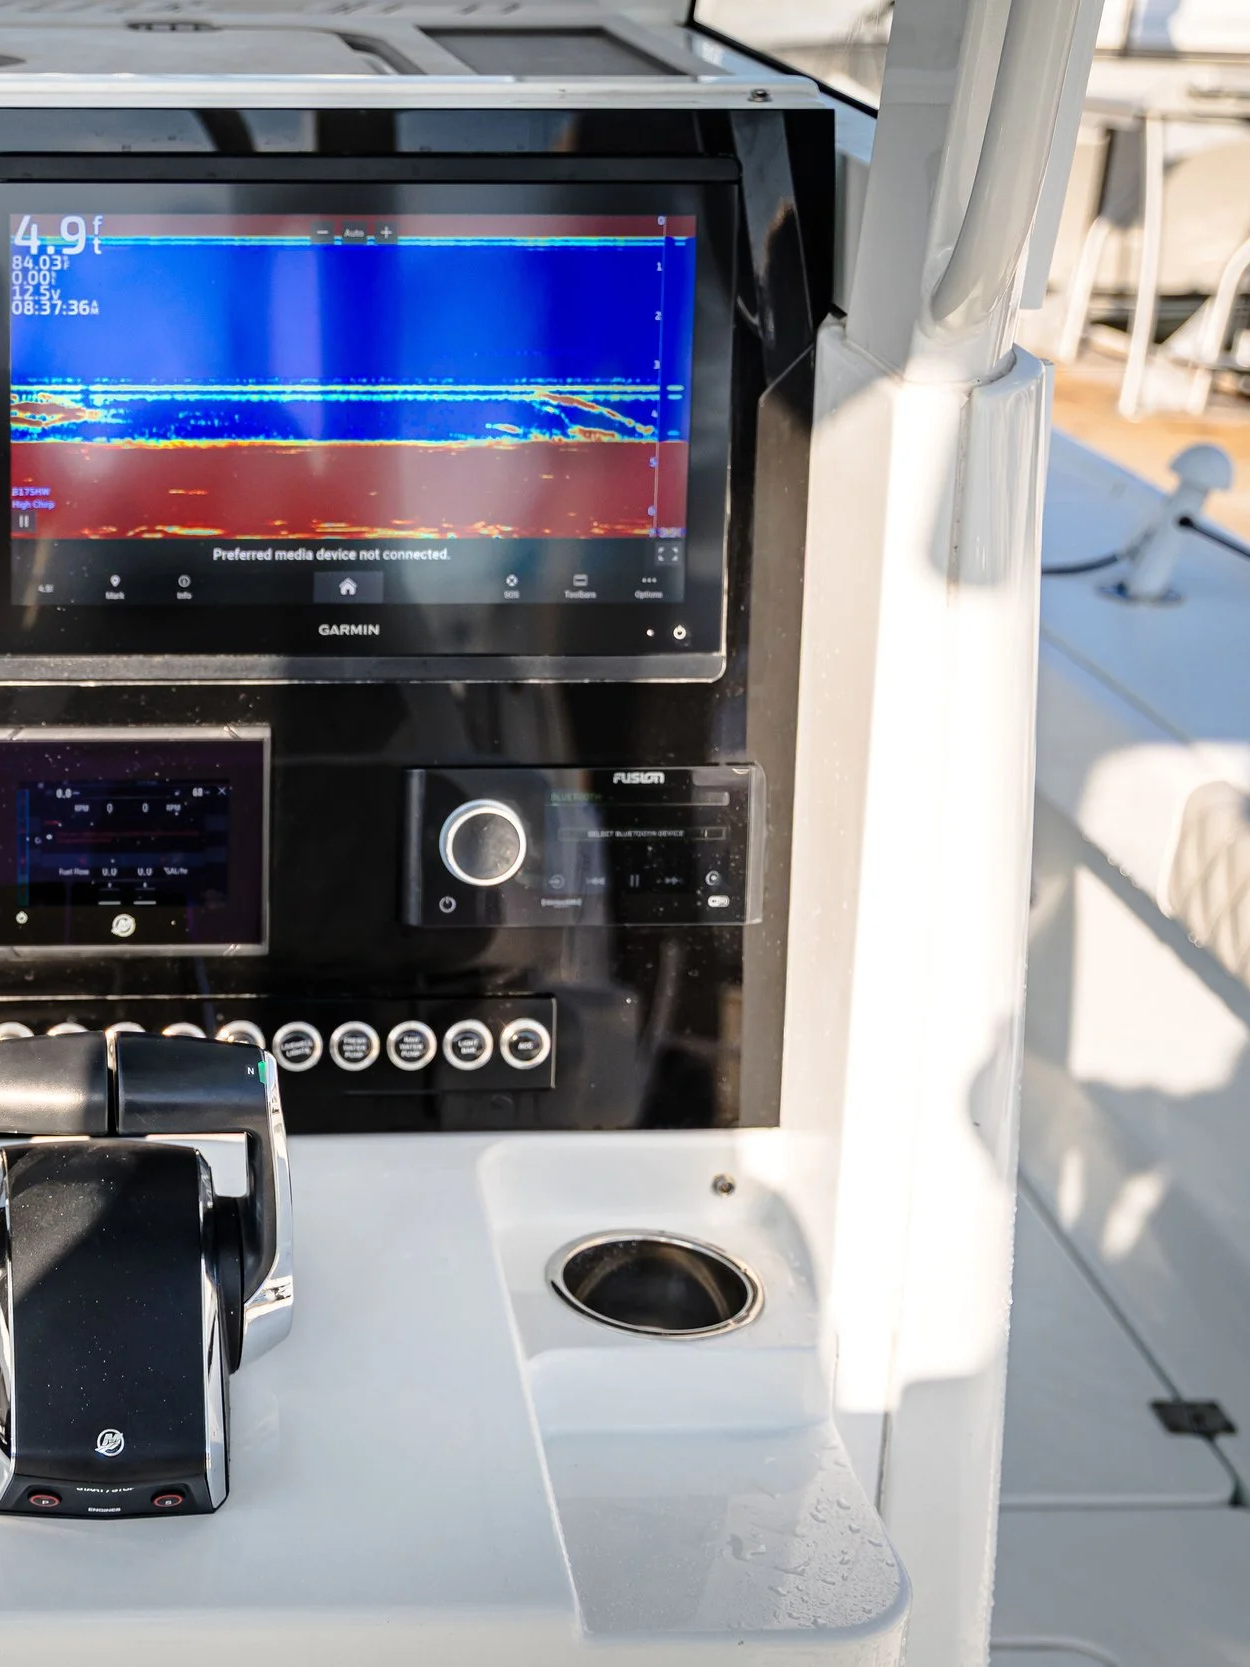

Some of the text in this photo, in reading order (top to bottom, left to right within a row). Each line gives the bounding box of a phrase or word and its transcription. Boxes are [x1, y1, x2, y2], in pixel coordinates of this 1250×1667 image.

[13, 214, 87, 256] 4.9
[12, 255, 62, 270] 84.03
[12, 270, 50, 285] 0.00
[12, 300, 90, 315] 08:37:36
[213, 547, 451, 561] Preferred media device not connected.
[318, 624, 380, 635] GARMIN
[612, 772, 665, 784] FUSION
[247, 1067, 255, 1075] N
